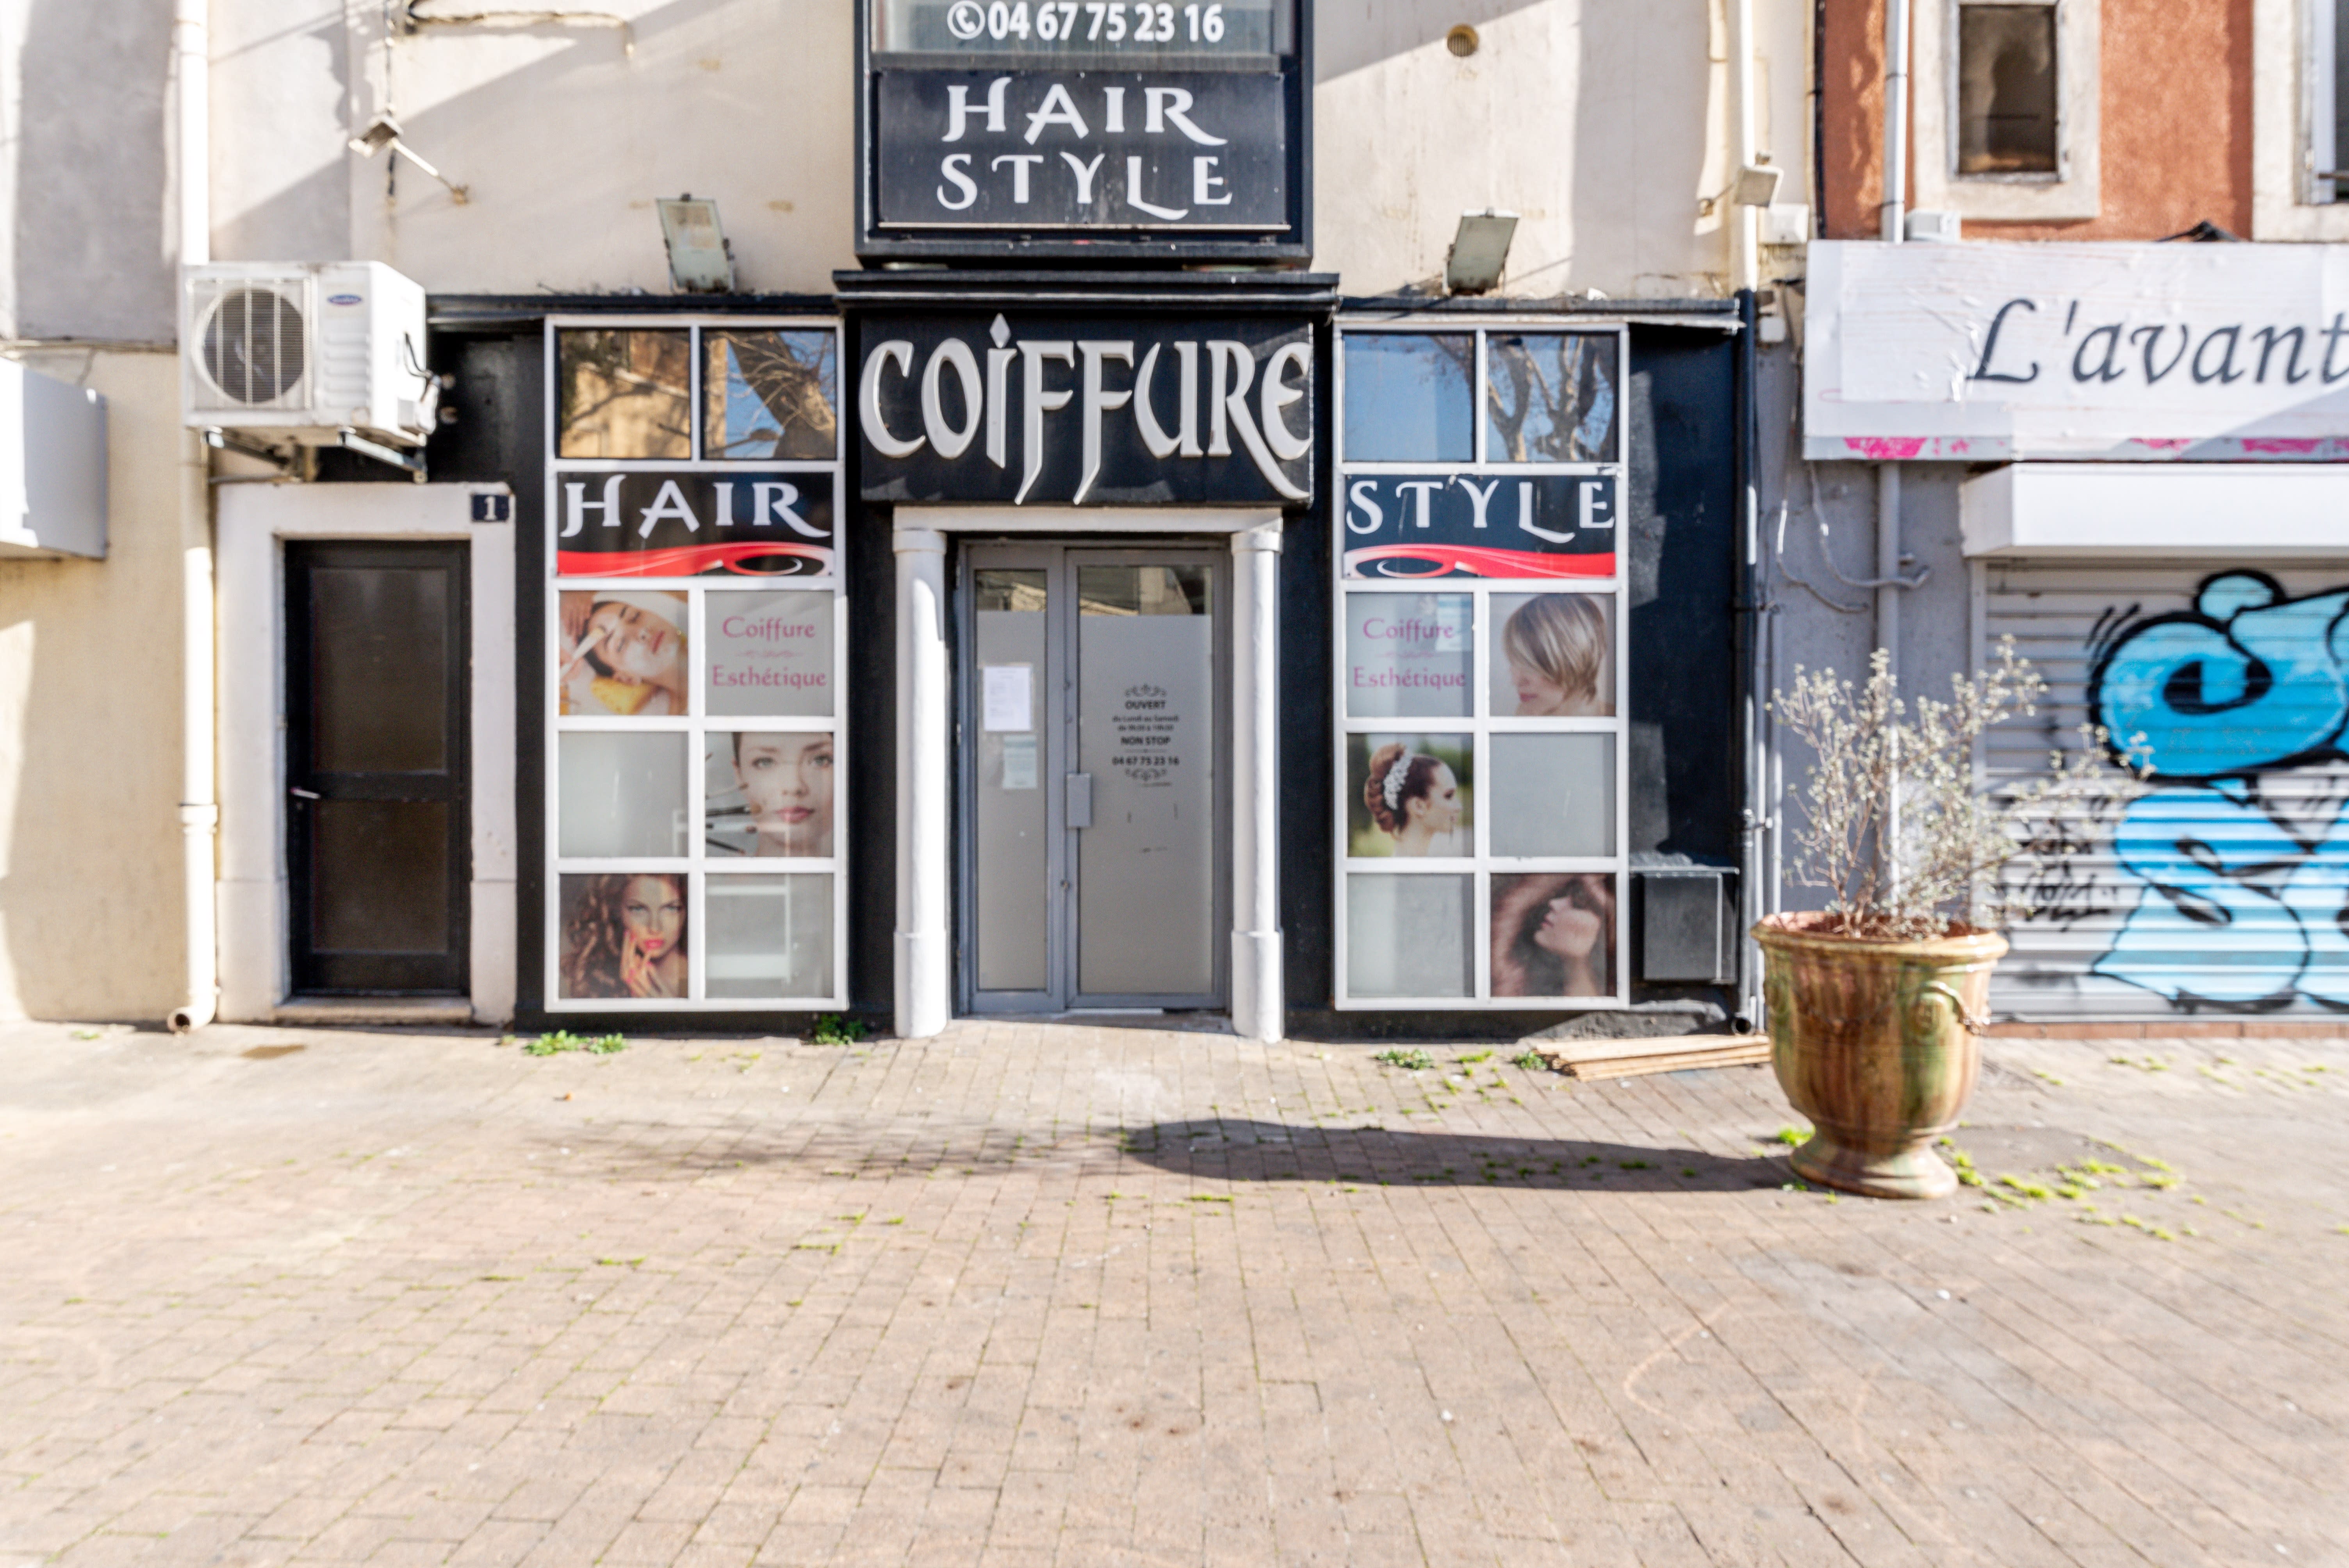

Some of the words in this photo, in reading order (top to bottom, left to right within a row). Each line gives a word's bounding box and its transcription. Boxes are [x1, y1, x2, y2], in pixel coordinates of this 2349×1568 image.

[987, 1, 1030, 40] 04
[1036, 2, 1078, 41] 67
[1085, 2, 1126, 41] 75
[1134, 3, 1175, 42] 23
[1184, 3, 1224, 43] 16
[941, 77, 1228, 146] HAIR
[936, 151, 1233, 221] STYLE
[484, 495, 497, 520] 1
[560, 474, 832, 539] HAIR
[1346, 478, 1616, 543] STYLE
[722, 616, 816, 642] Coiffure
[1363, 618, 1454, 643] Coiffure
[713, 665, 827, 691] Esthétique
[1353, 666, 1466, 691] Esthétique
[1125, 700, 1166, 709] OUVERT
[1121, 736, 1143, 745] NON
[1146, 736, 1171, 745] STOP
[1112, 756, 1125, 766] 04
[1126, 756, 1138, 765] 67
[1140, 756, 1151, 766] 75
[1154, 756, 1166, 766] 23
[1168, 756, 1180, 766] 16
